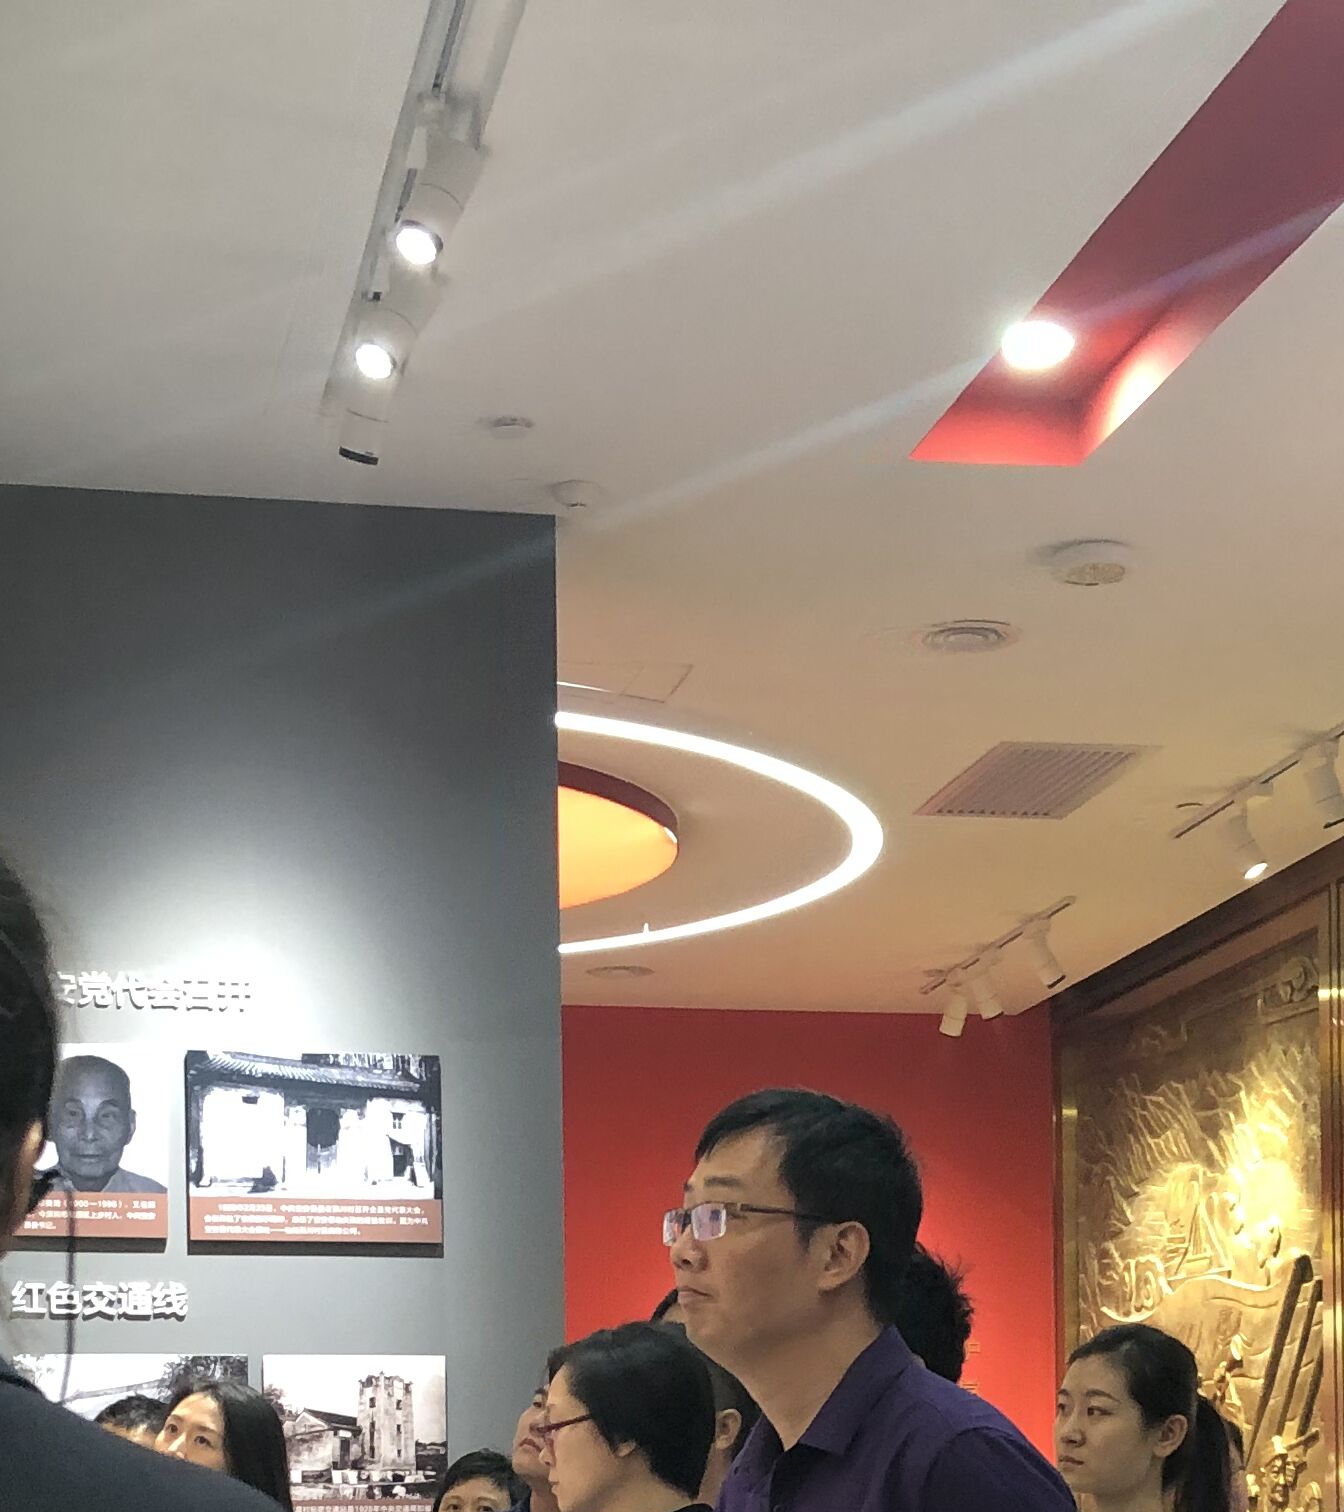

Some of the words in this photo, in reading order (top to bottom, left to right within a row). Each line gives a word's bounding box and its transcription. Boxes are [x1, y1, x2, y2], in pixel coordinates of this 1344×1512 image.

[11, 1280, 189, 1320] 红色交通线
